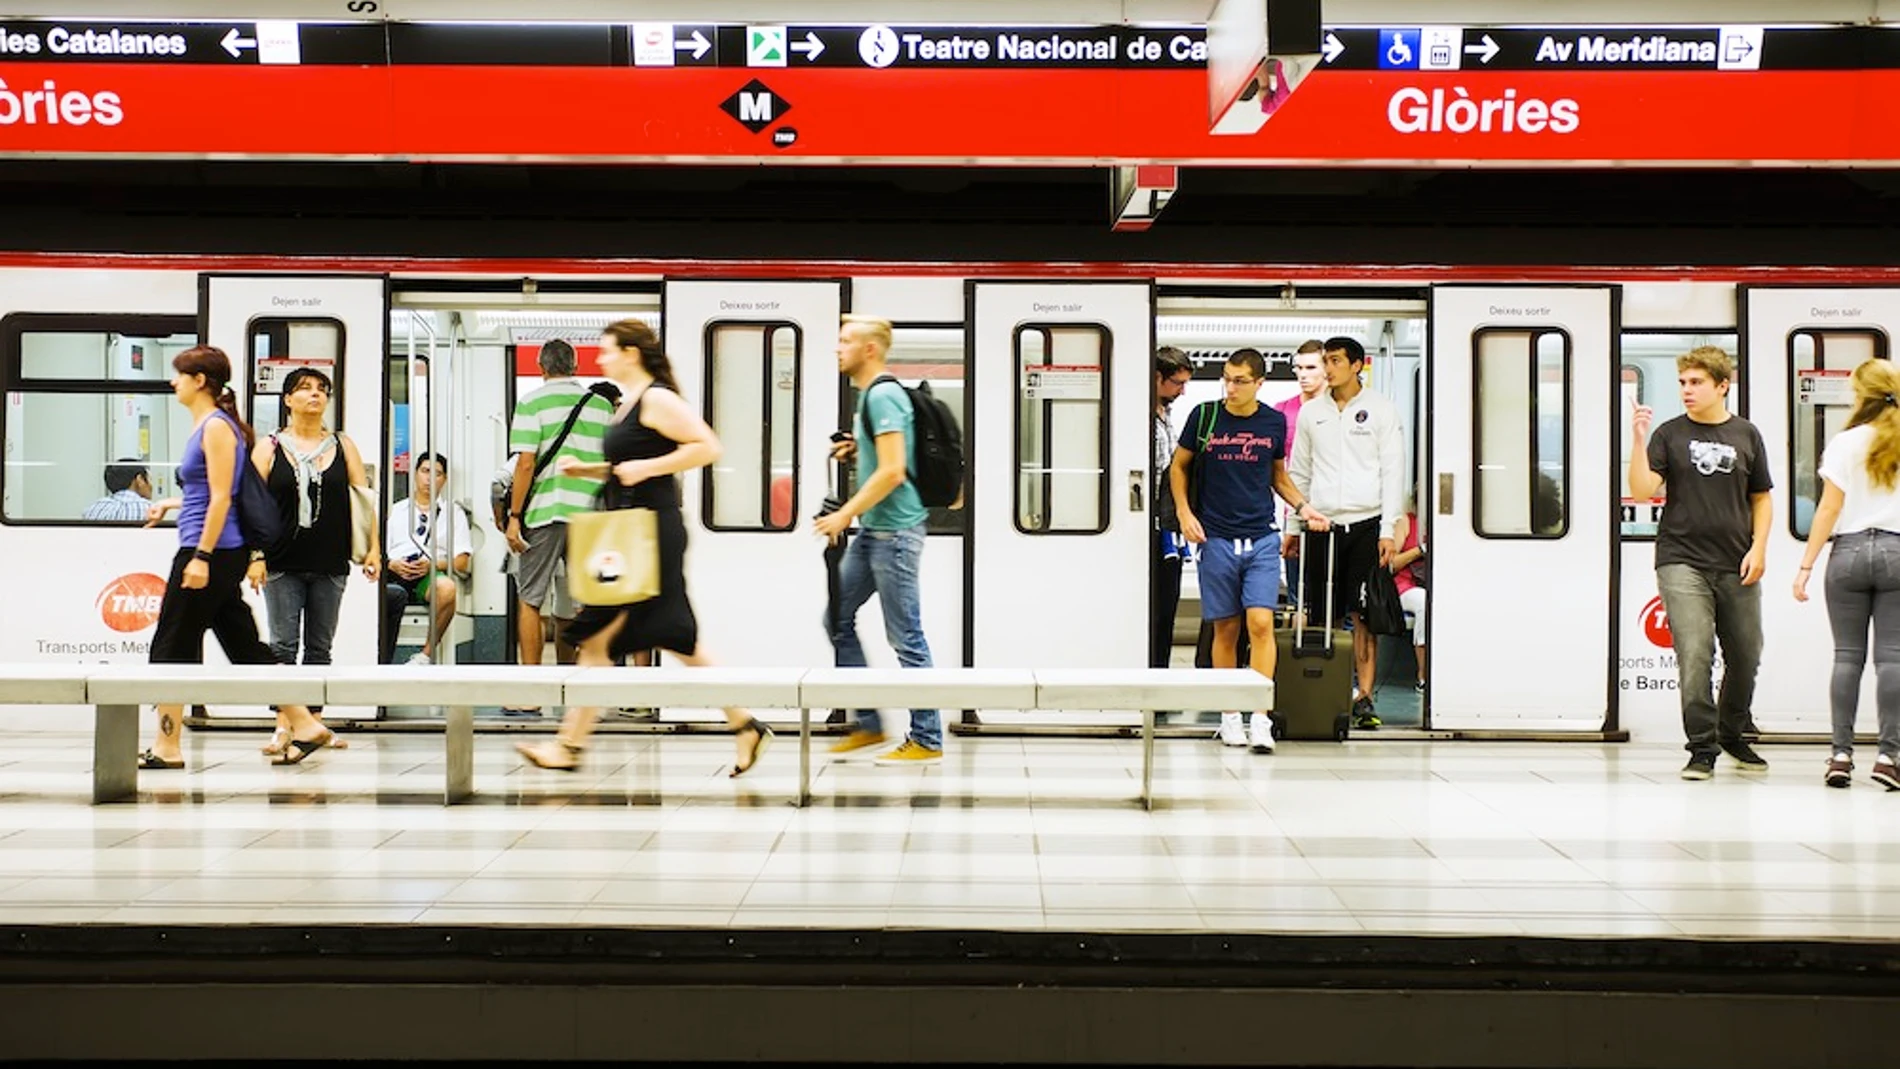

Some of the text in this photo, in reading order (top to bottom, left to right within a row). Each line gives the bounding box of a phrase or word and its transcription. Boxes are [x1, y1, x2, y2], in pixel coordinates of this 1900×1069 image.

[47, 28, 187, 54] Catalanes
[903, 34, 990, 60] Teatre
[997, 35, 1117, 60] Nacional
[1126, 36, 1162, 60] de
[1535, 37, 1716, 62] Av Meridiana
[740, 92, 771, 121] M
[1388, 86, 1580, 134] Glòries
[271, 296, 322, 307] Dejen salir
[719, 299, 780, 310] Deixeu sortir
[1033, 302, 1082, 314] Dejen salir
[1489, 304, 1551, 316] Deixeu sortir
[1810, 306, 1862, 318] Dejen salir
[111, 594, 162, 614] TMB
[1654, 610, 1669, 629] T
[37, 640, 116, 654] Transports
